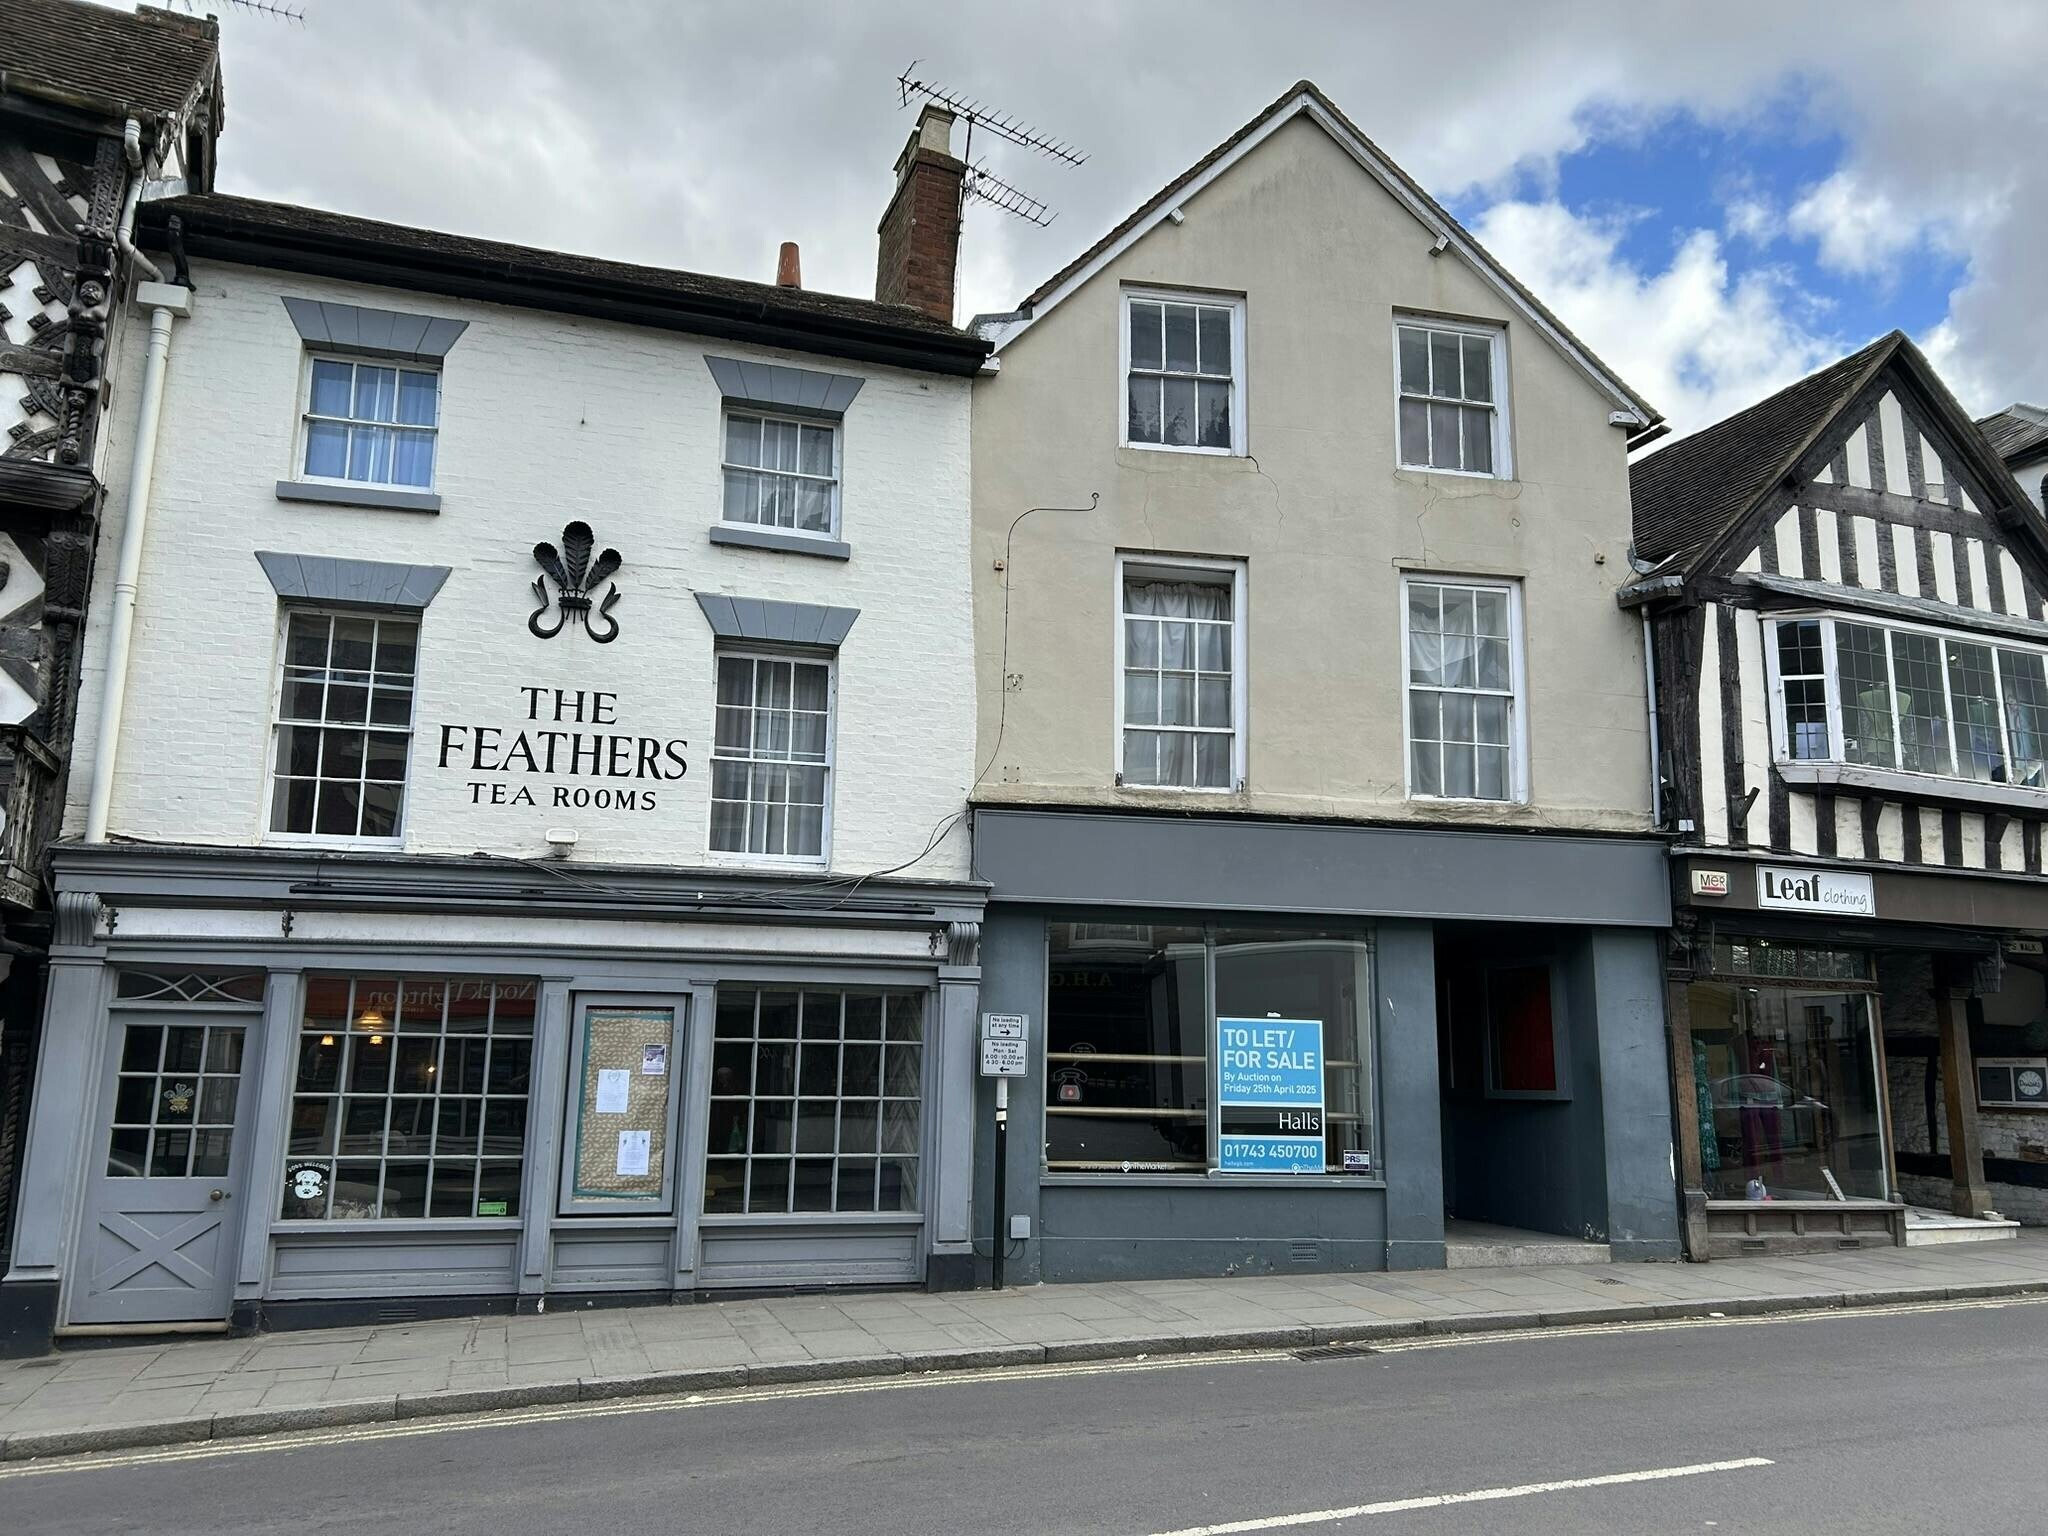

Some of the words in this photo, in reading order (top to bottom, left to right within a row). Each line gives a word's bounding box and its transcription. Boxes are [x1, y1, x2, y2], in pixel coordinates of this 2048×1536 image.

[521, 687, 618, 725] THE
[437, 724, 688, 780] FEATHERS
[467, 783, 536, 806] TEA
[552, 786, 657, 811] ROOMS
[1764, 871, 1821, 902] Leaf
[1823, 888, 1867, 912] clothing
[1223, 1028, 1248, 1047] TO
[1252, 1029, 1295, 1048] LET/
[1223, 1050, 1261, 1068] FOR
[1267, 1051, 1315, 1070] SALE
[1224, 1072, 1235, 1082] By
[1237, 1072, 1269, 1081] Auction
[1224, 1083, 1251, 1094] Friday
[1253, 1084, 1272, 1093] 25th
[1273, 1085, 1294, 1095] April
[1296, 1085, 1316, 1094] 2025
[1279, 1111, 1319, 1130] Halls
[1224, 1144, 1265, 1157] 01743
[1269, 1145, 1317, 1158] 450700
[1345, 1155, 1361, 1163] PRS
